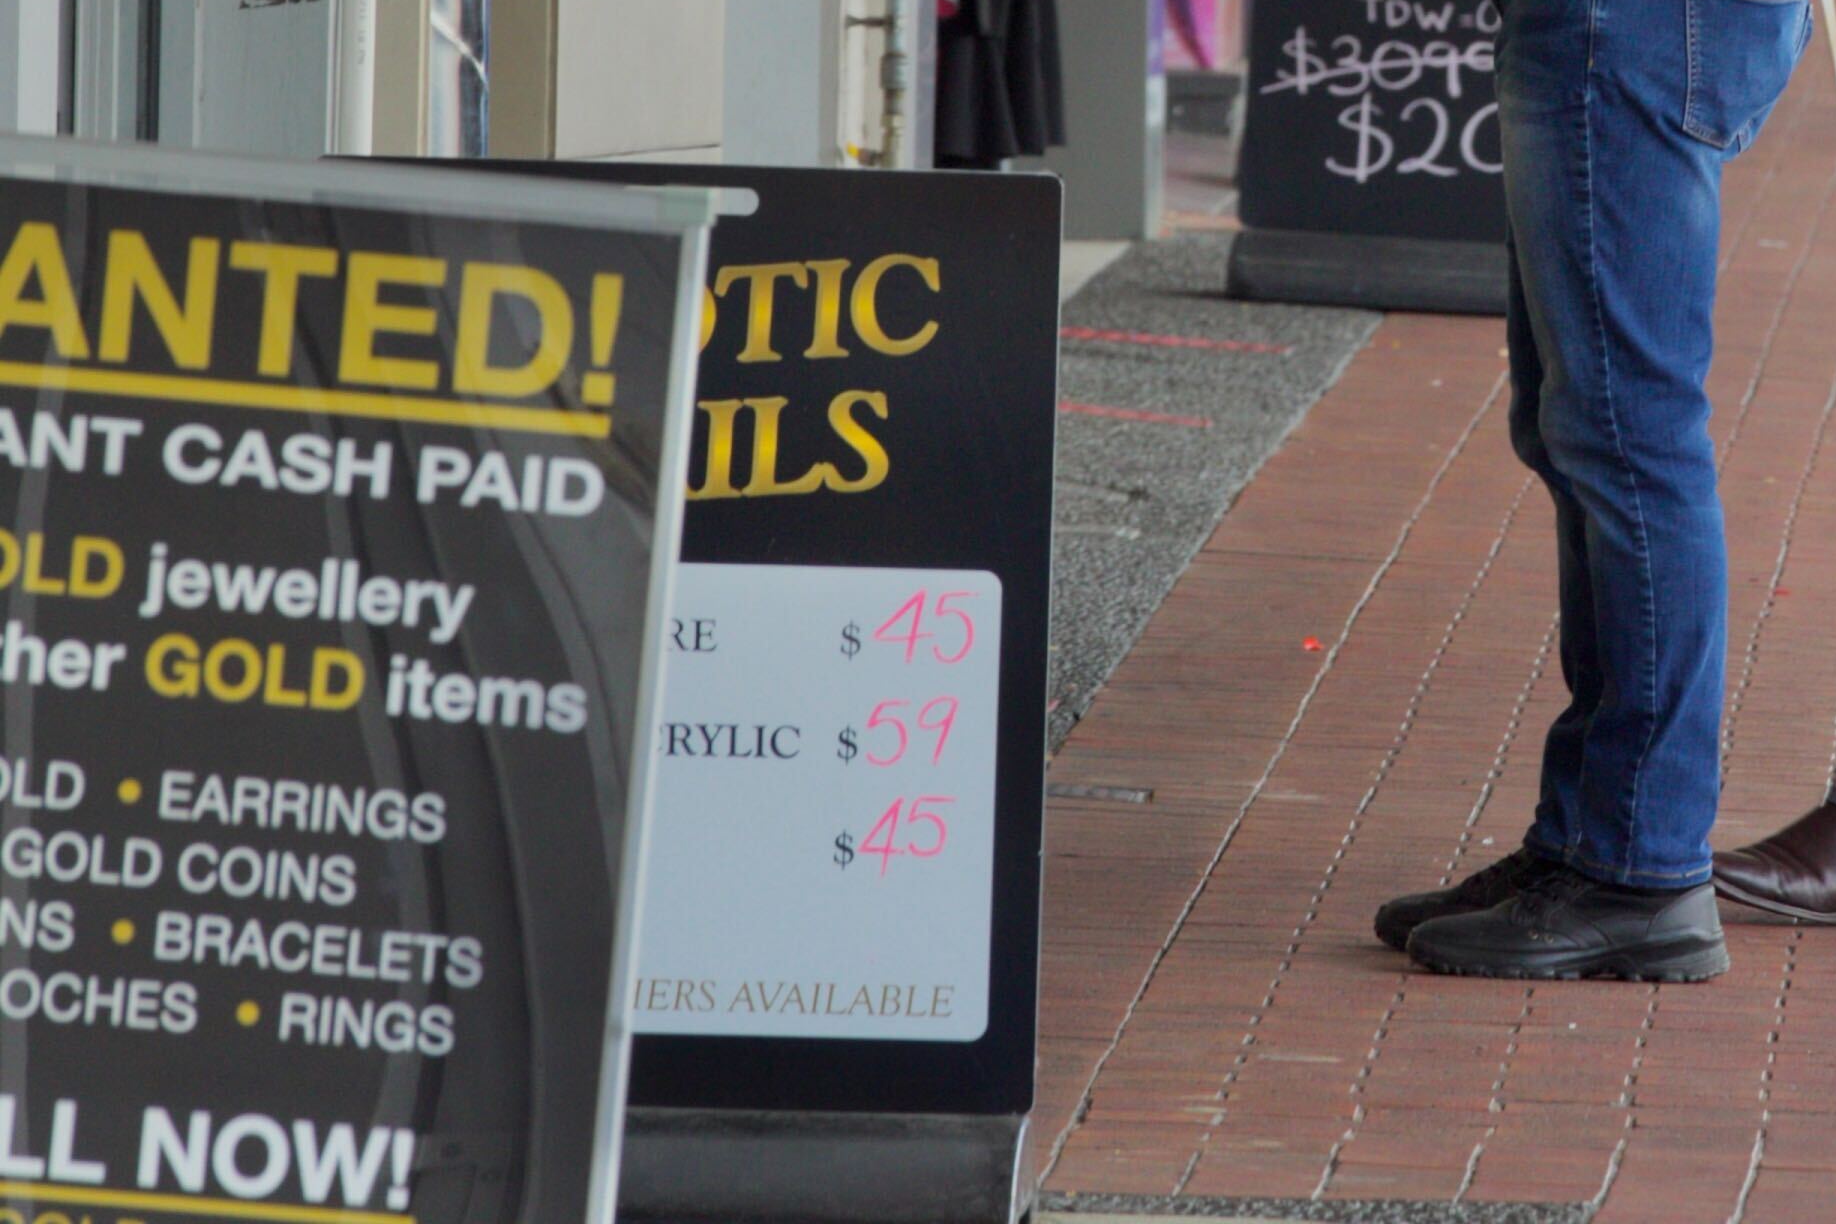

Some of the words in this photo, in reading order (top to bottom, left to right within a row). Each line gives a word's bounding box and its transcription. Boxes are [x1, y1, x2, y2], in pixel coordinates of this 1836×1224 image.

[697, 253, 940, 363] TIC
[162, 423, 392, 500] CASH
[417, 446, 606, 517] PAID
[685, 390, 889, 500] ILS
[139, 542, 475, 644] jewellery
[144, 633, 366, 711] GOLD
[386, 655, 588, 733] items
[658, 723, 801, 760] RYLIC
[158, 770, 447, 844] EARRINGS
[2, 826, 163, 888] GOLD
[178, 843, 357, 906] COINS
[154, 911, 484, 989] BRACELETS
[279, 992, 456, 1056] RINGS
[728, 982, 956, 1019] AVAILABLE
[137, 1105, 417, 1211] NOW!
